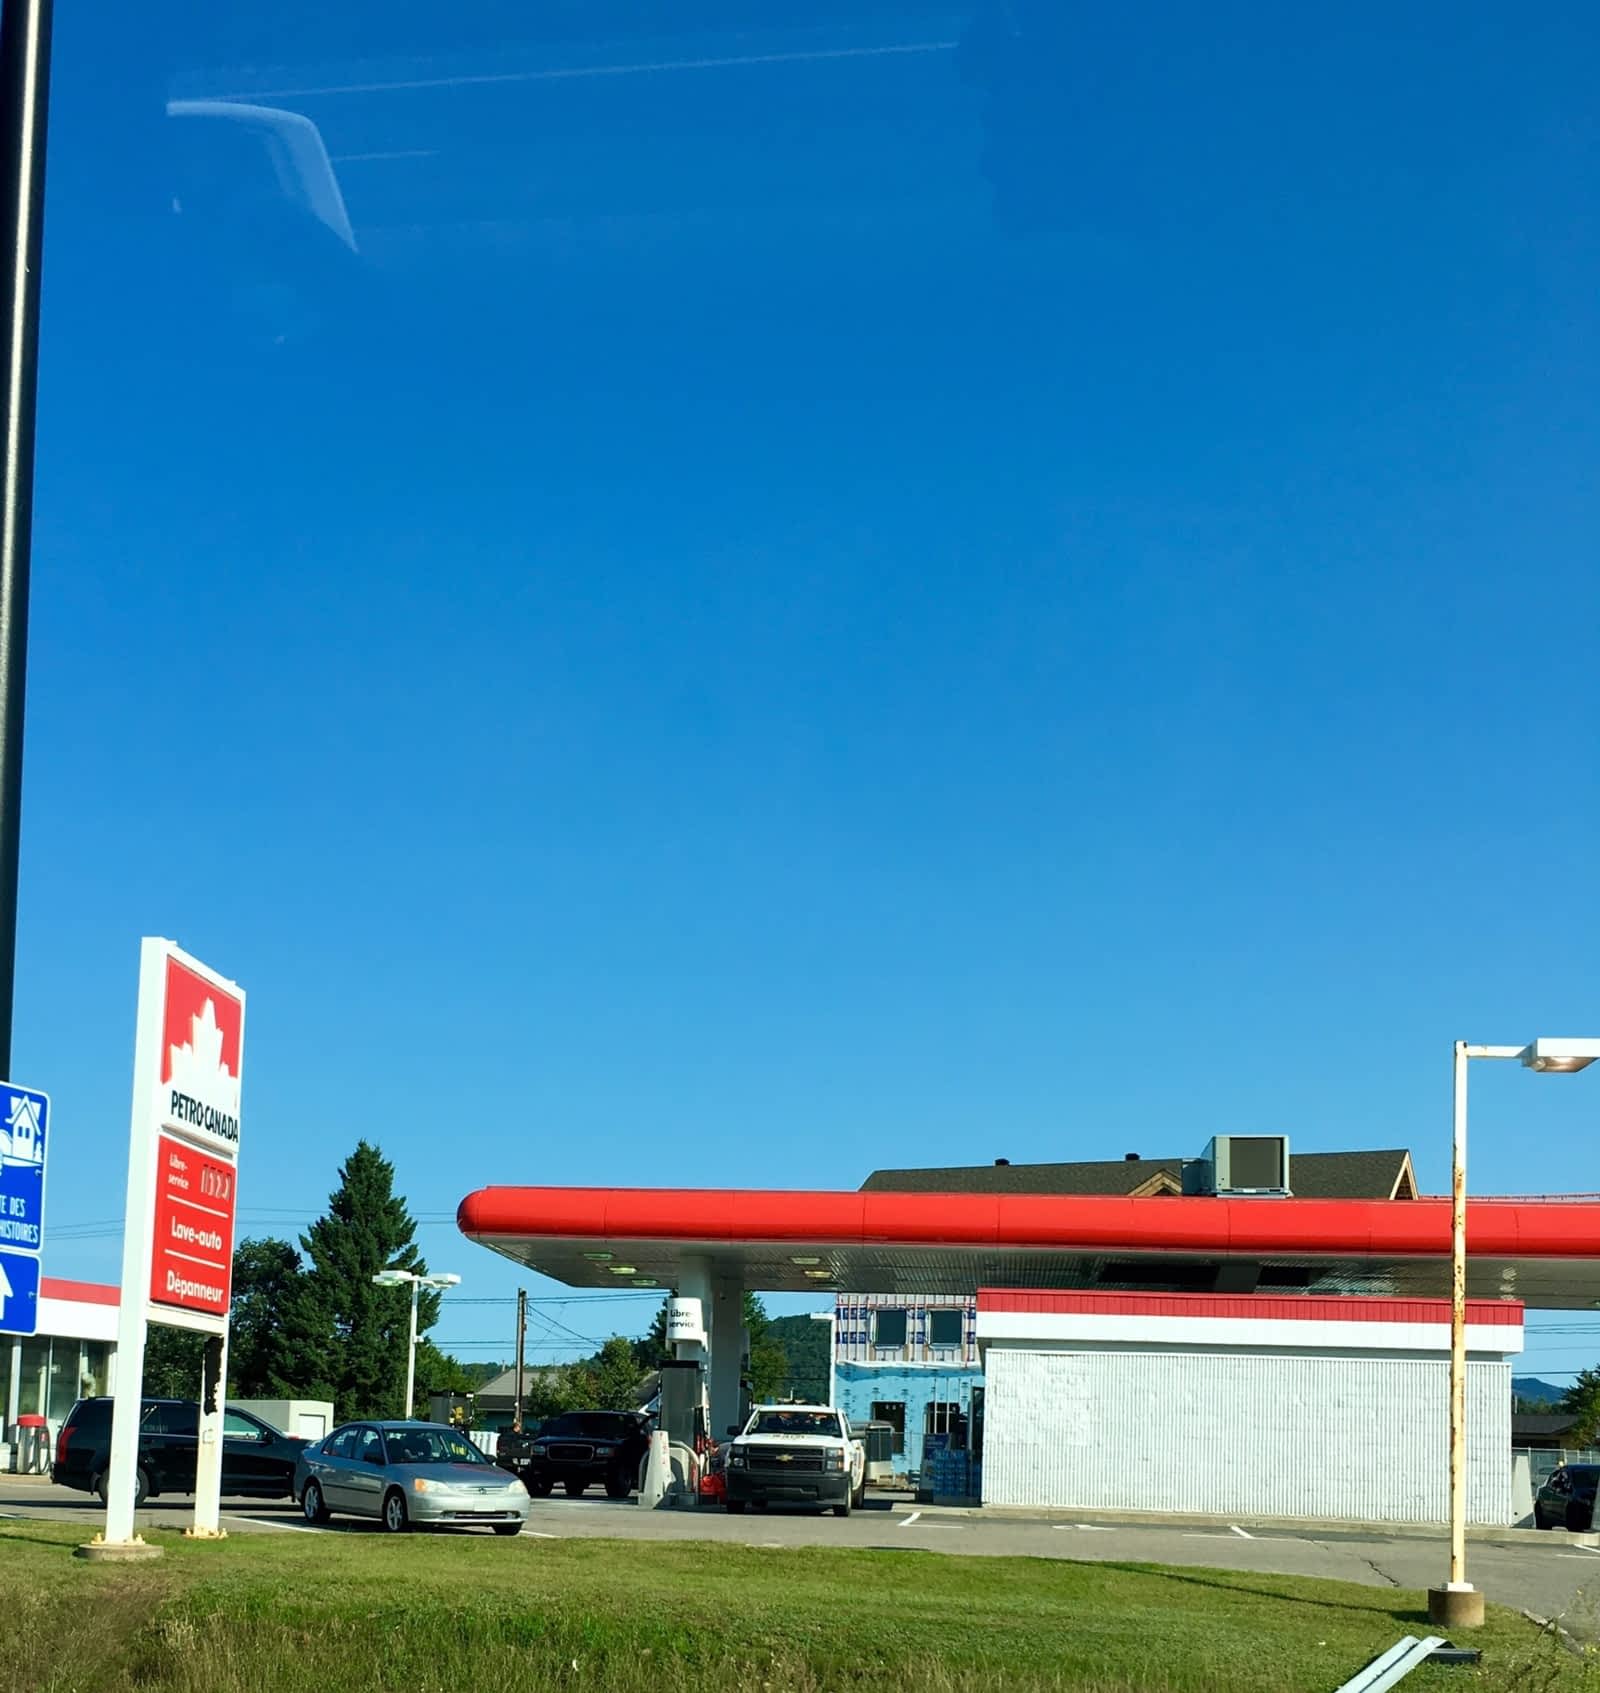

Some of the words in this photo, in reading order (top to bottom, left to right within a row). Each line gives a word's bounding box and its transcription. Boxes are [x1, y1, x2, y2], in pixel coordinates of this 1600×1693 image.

[9, 1196, 26, 1217] DES
[171, 1215, 222, 1251] Lave-auto
[166, 1269, 224, 1303] Dépanneur
